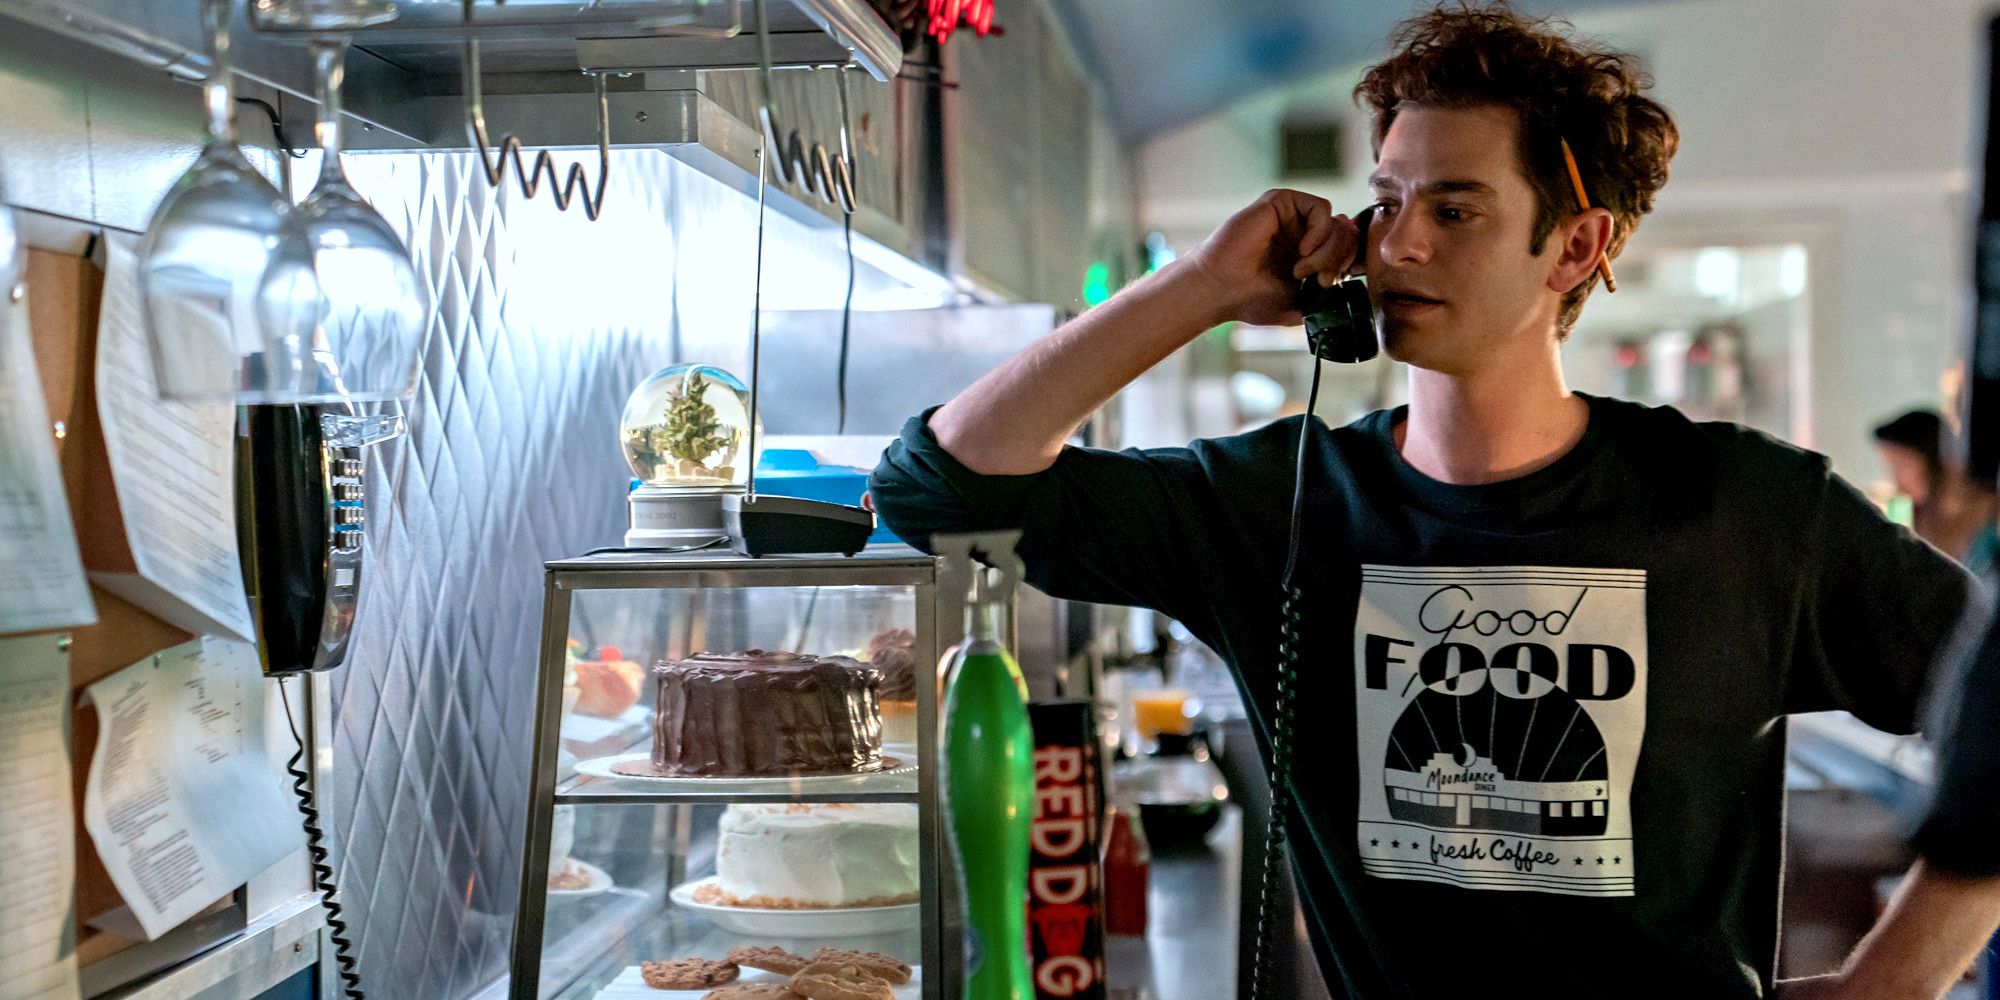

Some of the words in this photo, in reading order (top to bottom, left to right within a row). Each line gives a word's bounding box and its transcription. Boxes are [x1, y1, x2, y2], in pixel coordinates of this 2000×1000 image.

[1419, 585, 1588, 643] Good
[1365, 634, 1636, 701] FOOD
[1031, 745, 1085, 858] RED
[1426, 767, 1496, 791] Moondance
[1474, 783, 1497, 792] DINER
[1429, 835, 1487, 865] fresh
[1490, 838, 1560, 872] Coffee
[1032, 864, 1093, 997] DG
